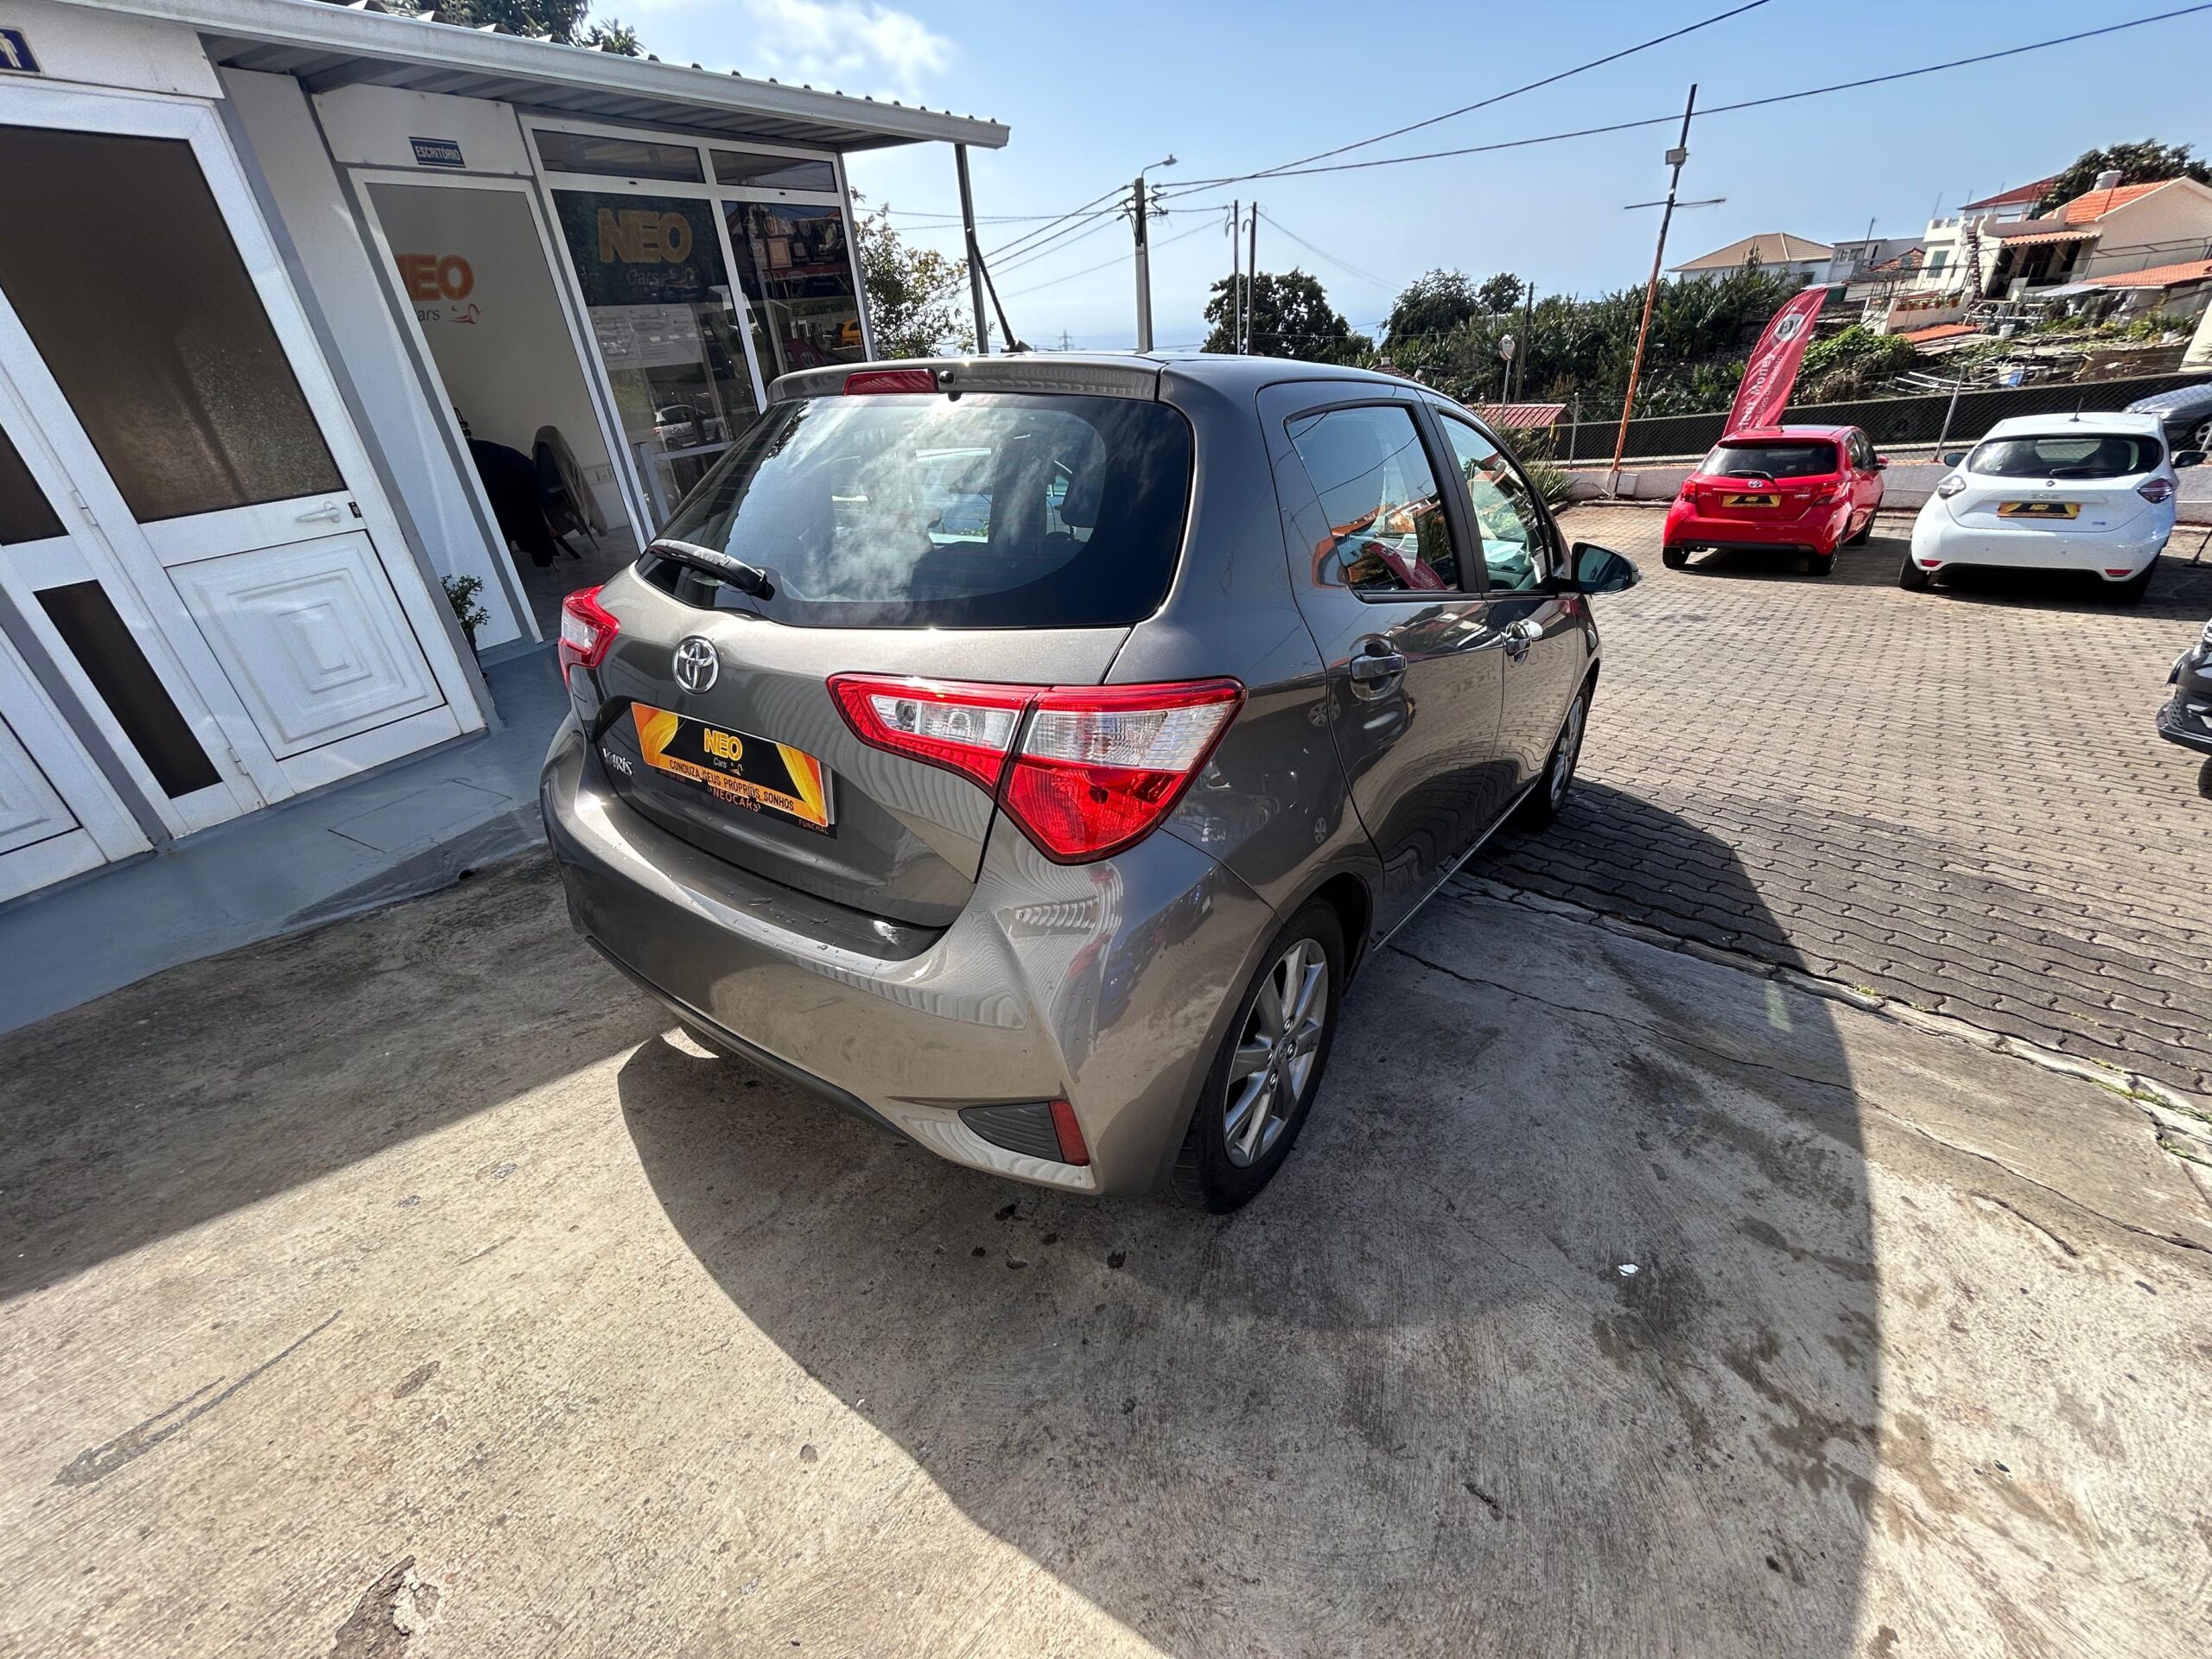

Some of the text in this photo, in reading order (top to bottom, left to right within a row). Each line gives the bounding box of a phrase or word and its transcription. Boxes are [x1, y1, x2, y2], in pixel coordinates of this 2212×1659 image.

[415, 145, 461, 161] ESCRITÓRIO
[598, 207, 692, 264] NEO
[627, 269, 659, 285] Cars
[414, 307, 441, 321] ars
[1750, 353, 1776, 395] Money
[703, 728, 743, 761] NEO
[713, 757, 728, 768] Cars
[669, 760, 701, 779] CONDUZA
[763, 791, 794, 811] SONHOS
[712, 788, 759, 812] NEOCARS
[798, 818, 830, 835] FUNCHAL
